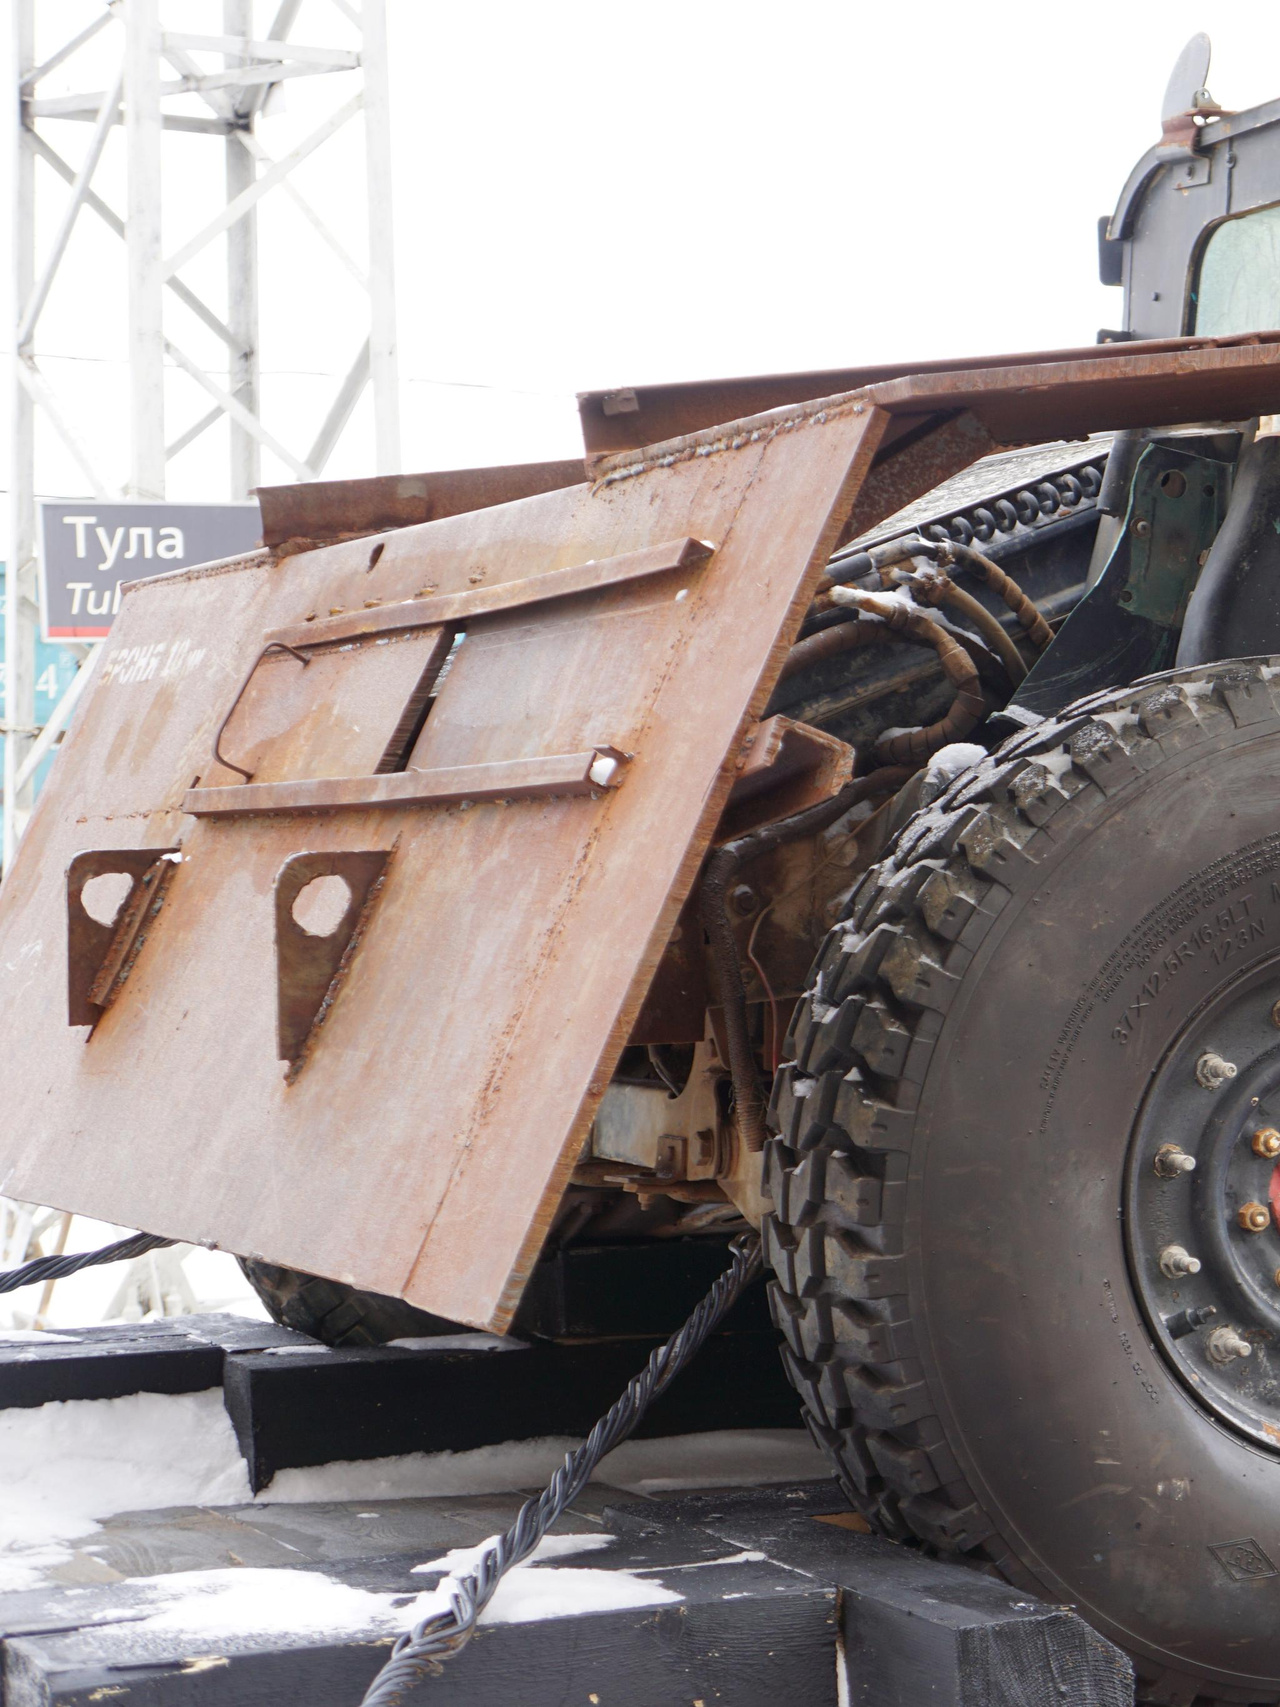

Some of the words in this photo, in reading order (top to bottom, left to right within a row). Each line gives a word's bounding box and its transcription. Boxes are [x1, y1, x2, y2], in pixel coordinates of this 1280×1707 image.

[63, 516, 184, 571] Тула
[66, 580, 122, 615] Tul
[1209, 918, 1266, 966] 123N
